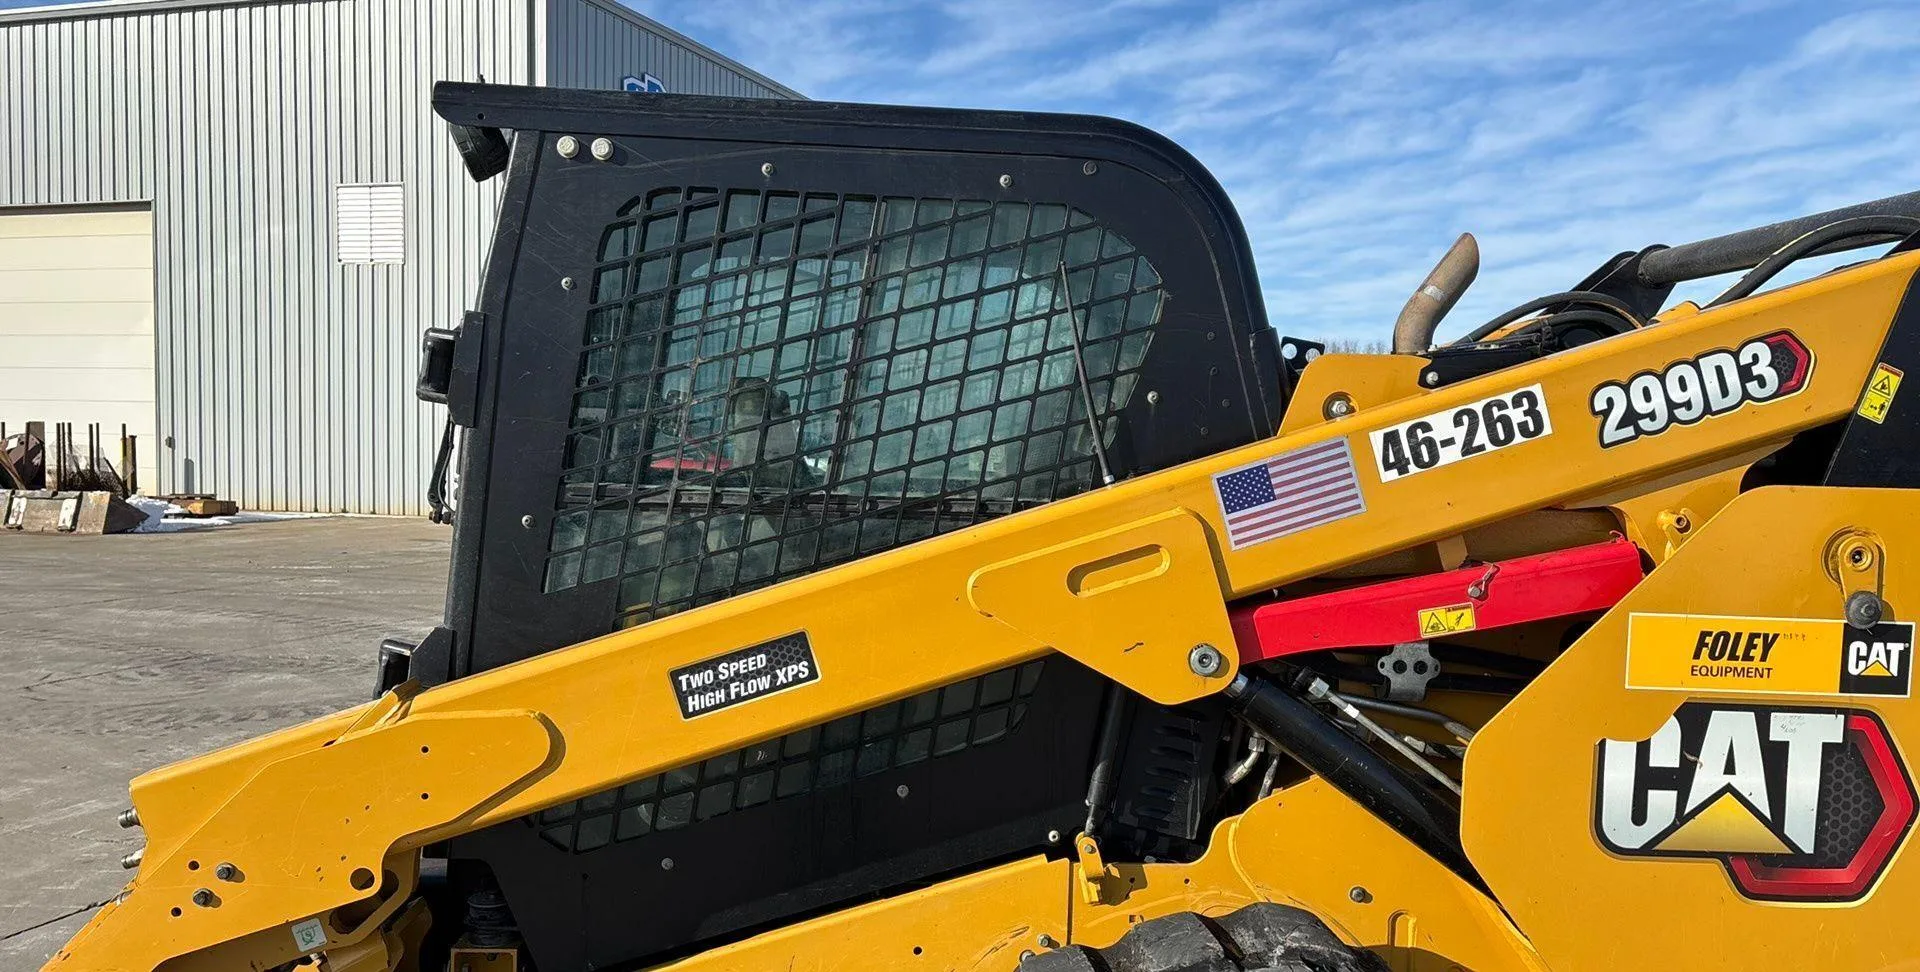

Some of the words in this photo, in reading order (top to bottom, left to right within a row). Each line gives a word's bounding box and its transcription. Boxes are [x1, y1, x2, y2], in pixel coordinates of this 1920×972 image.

[1593, 341, 1779, 445] 299D3
[1381, 390, 1544, 477] 46-263
[1691, 630, 1780, 663] FOLEY
[1848, 640, 1905, 677] CAT
[775, 660, 809, 686] XPS
[1690, 664, 1774, 679] EQUIPMENT
[1602, 710, 1845, 855] CAT
